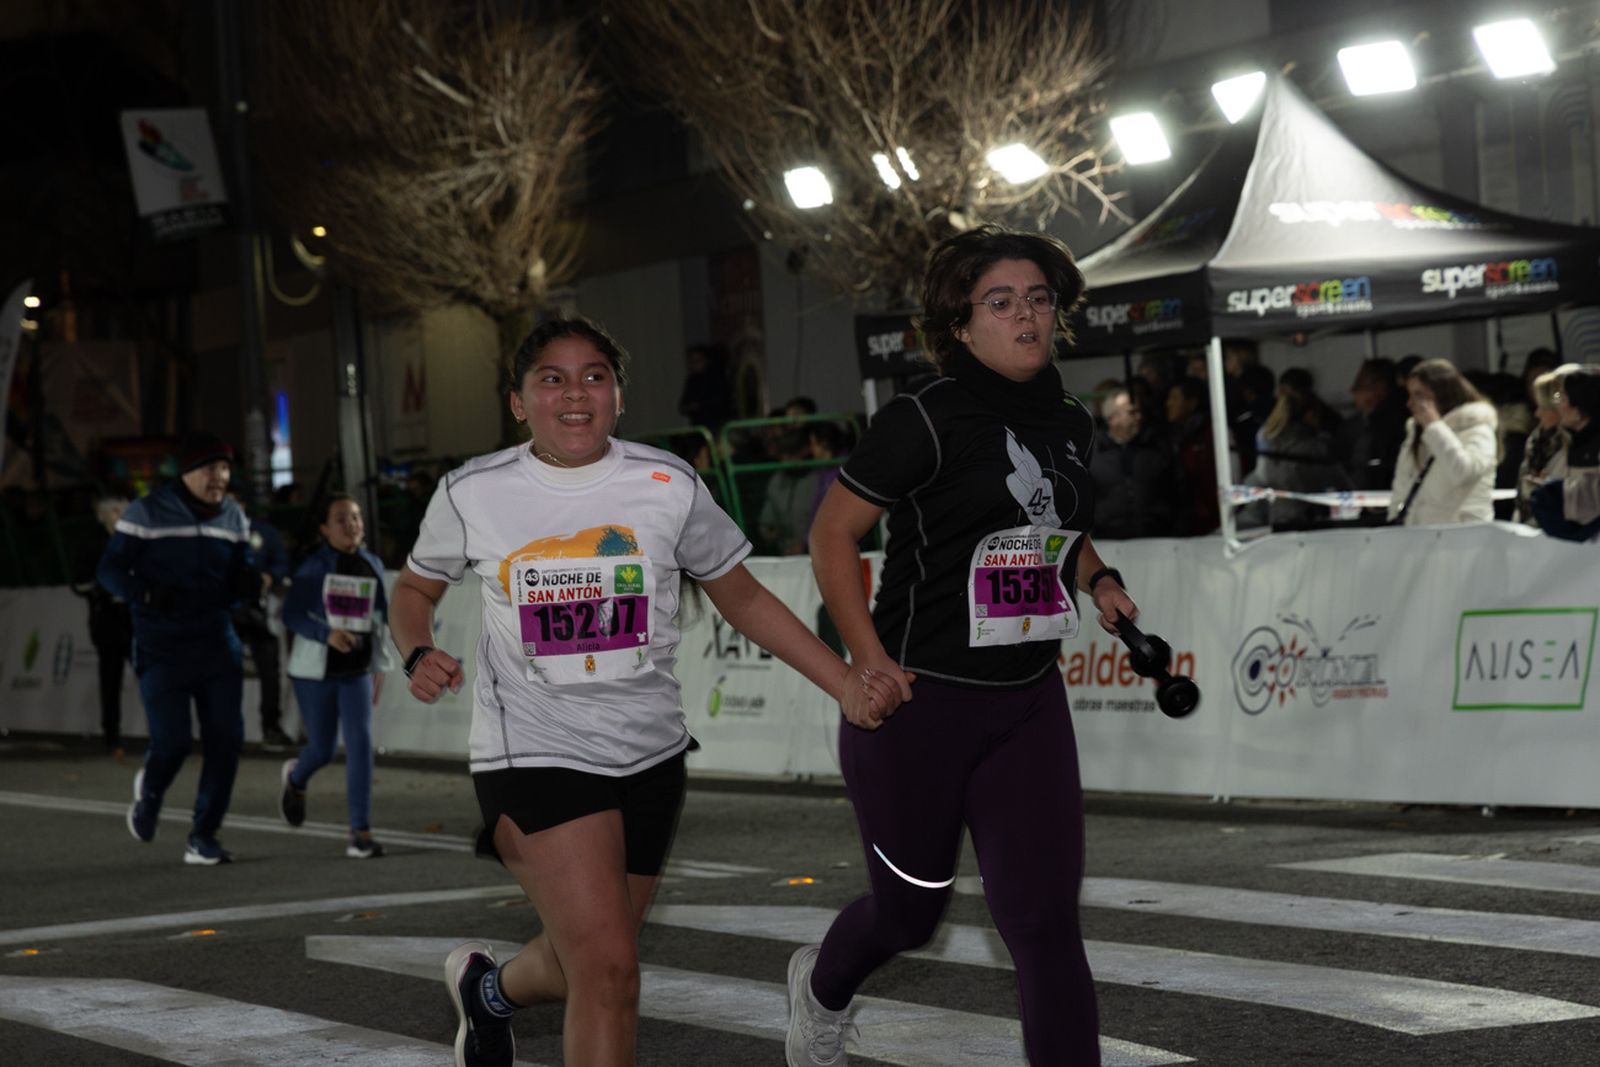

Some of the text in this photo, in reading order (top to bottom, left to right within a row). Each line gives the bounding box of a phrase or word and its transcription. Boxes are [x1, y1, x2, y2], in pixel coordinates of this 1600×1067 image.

[1421, 257, 1558, 299] superscreen
[1227, 276, 1372, 318] superscreen
[999, 539, 1033, 551] NOCHE
[984, 554, 1008, 566] SAN
[542, 573, 583, 586] NOCHE
[586, 572, 602, 583] DE
[528, 589, 554, 603] SAN
[557, 584, 602, 601] ANTÓN
[1465, 640, 1580, 680] ALISEA
